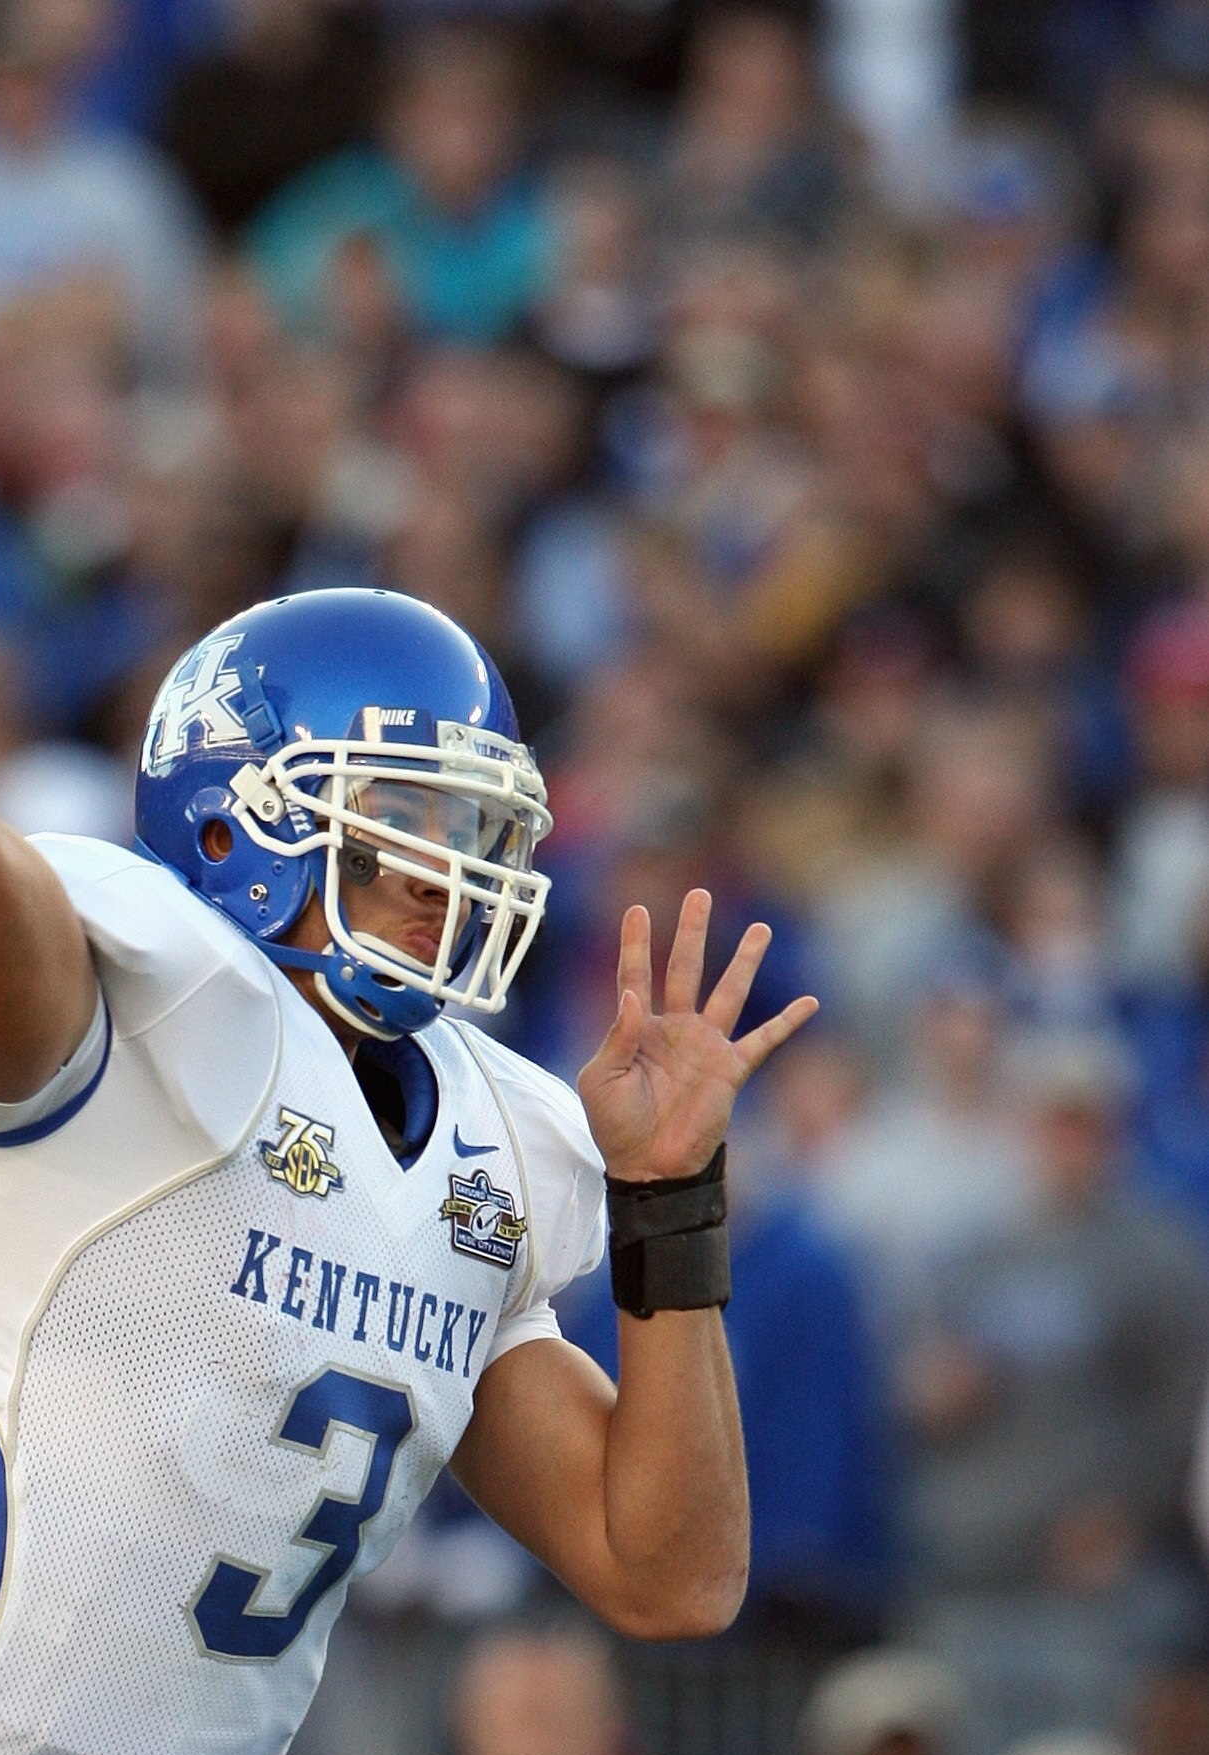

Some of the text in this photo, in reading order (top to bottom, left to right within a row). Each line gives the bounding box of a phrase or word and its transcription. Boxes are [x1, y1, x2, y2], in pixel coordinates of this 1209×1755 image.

[379, 709, 417, 726] NIKE
[271, 1107, 335, 1196] 75
[285, 1141, 320, 1194] SEC
[230, 1228, 487, 1378] KENTUCKY
[185, 1361, 418, 1666] 3
